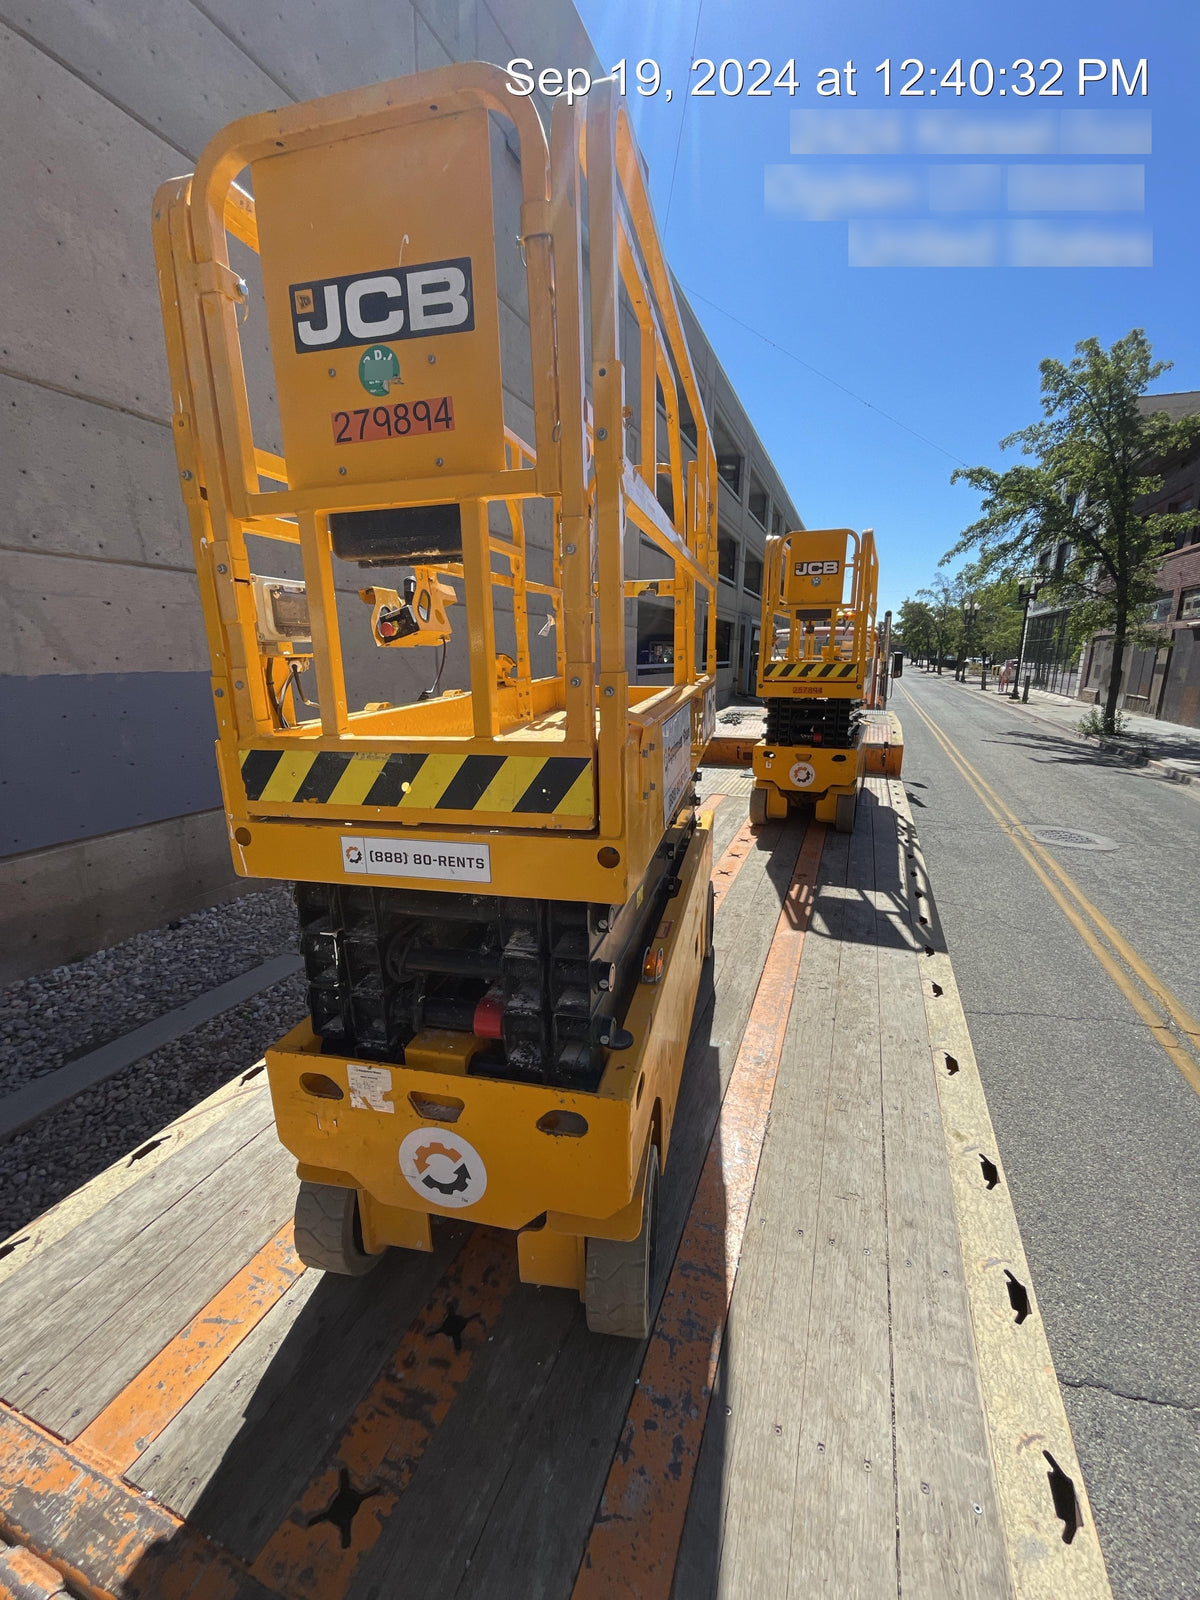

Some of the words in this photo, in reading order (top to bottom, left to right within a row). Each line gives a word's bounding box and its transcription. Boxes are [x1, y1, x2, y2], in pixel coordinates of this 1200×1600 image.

[297, 267, 469, 346] JCB
[334, 397, 453, 443] 279894
[795, 561, 838, 576] JCB
[369, 850, 408, 864] (888)
[413, 853, 485, 869] 80-RENTS
